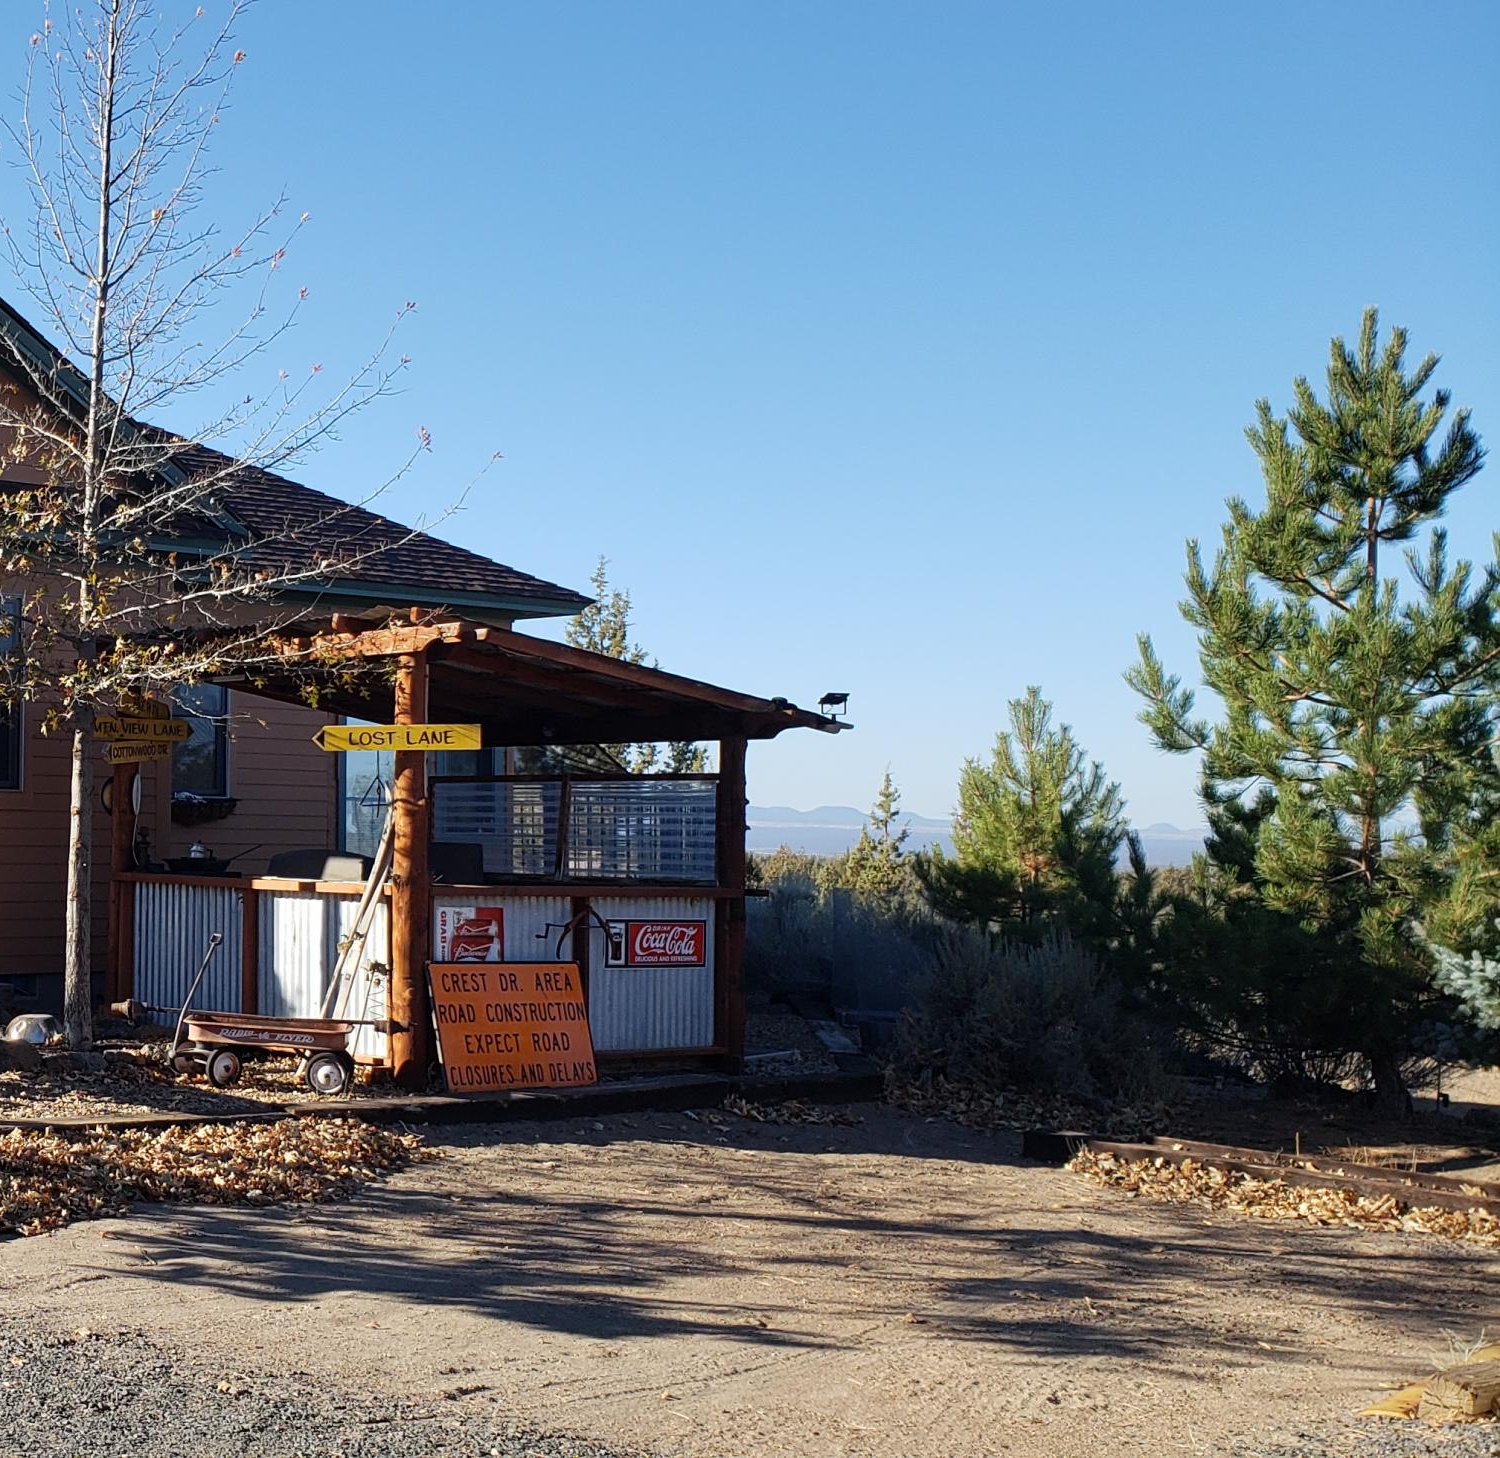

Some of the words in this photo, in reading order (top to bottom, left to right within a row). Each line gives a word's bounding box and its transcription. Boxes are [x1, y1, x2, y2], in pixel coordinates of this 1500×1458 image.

[121, 721, 148, 735] VIEW
[153, 724, 184, 736] LANE
[348, 731, 396, 746] LOST
[406, 730, 455, 745] LANE
[441, 973, 487, 992] CREST
[498, 973, 524, 992] DR.
[535, 973, 573, 992] AREA
[438, 1003, 476, 1024] ROAD
[485, 1002, 586, 1022] CONSTRUCTION
[464, 1033, 520, 1054] EXPECT
[532, 1032, 570, 1052] ROAD
[450, 1064, 515, 1086] CLOSURES
[520, 1063, 544, 1083] AND
[549, 1062, 594, 1082] DELAYS
